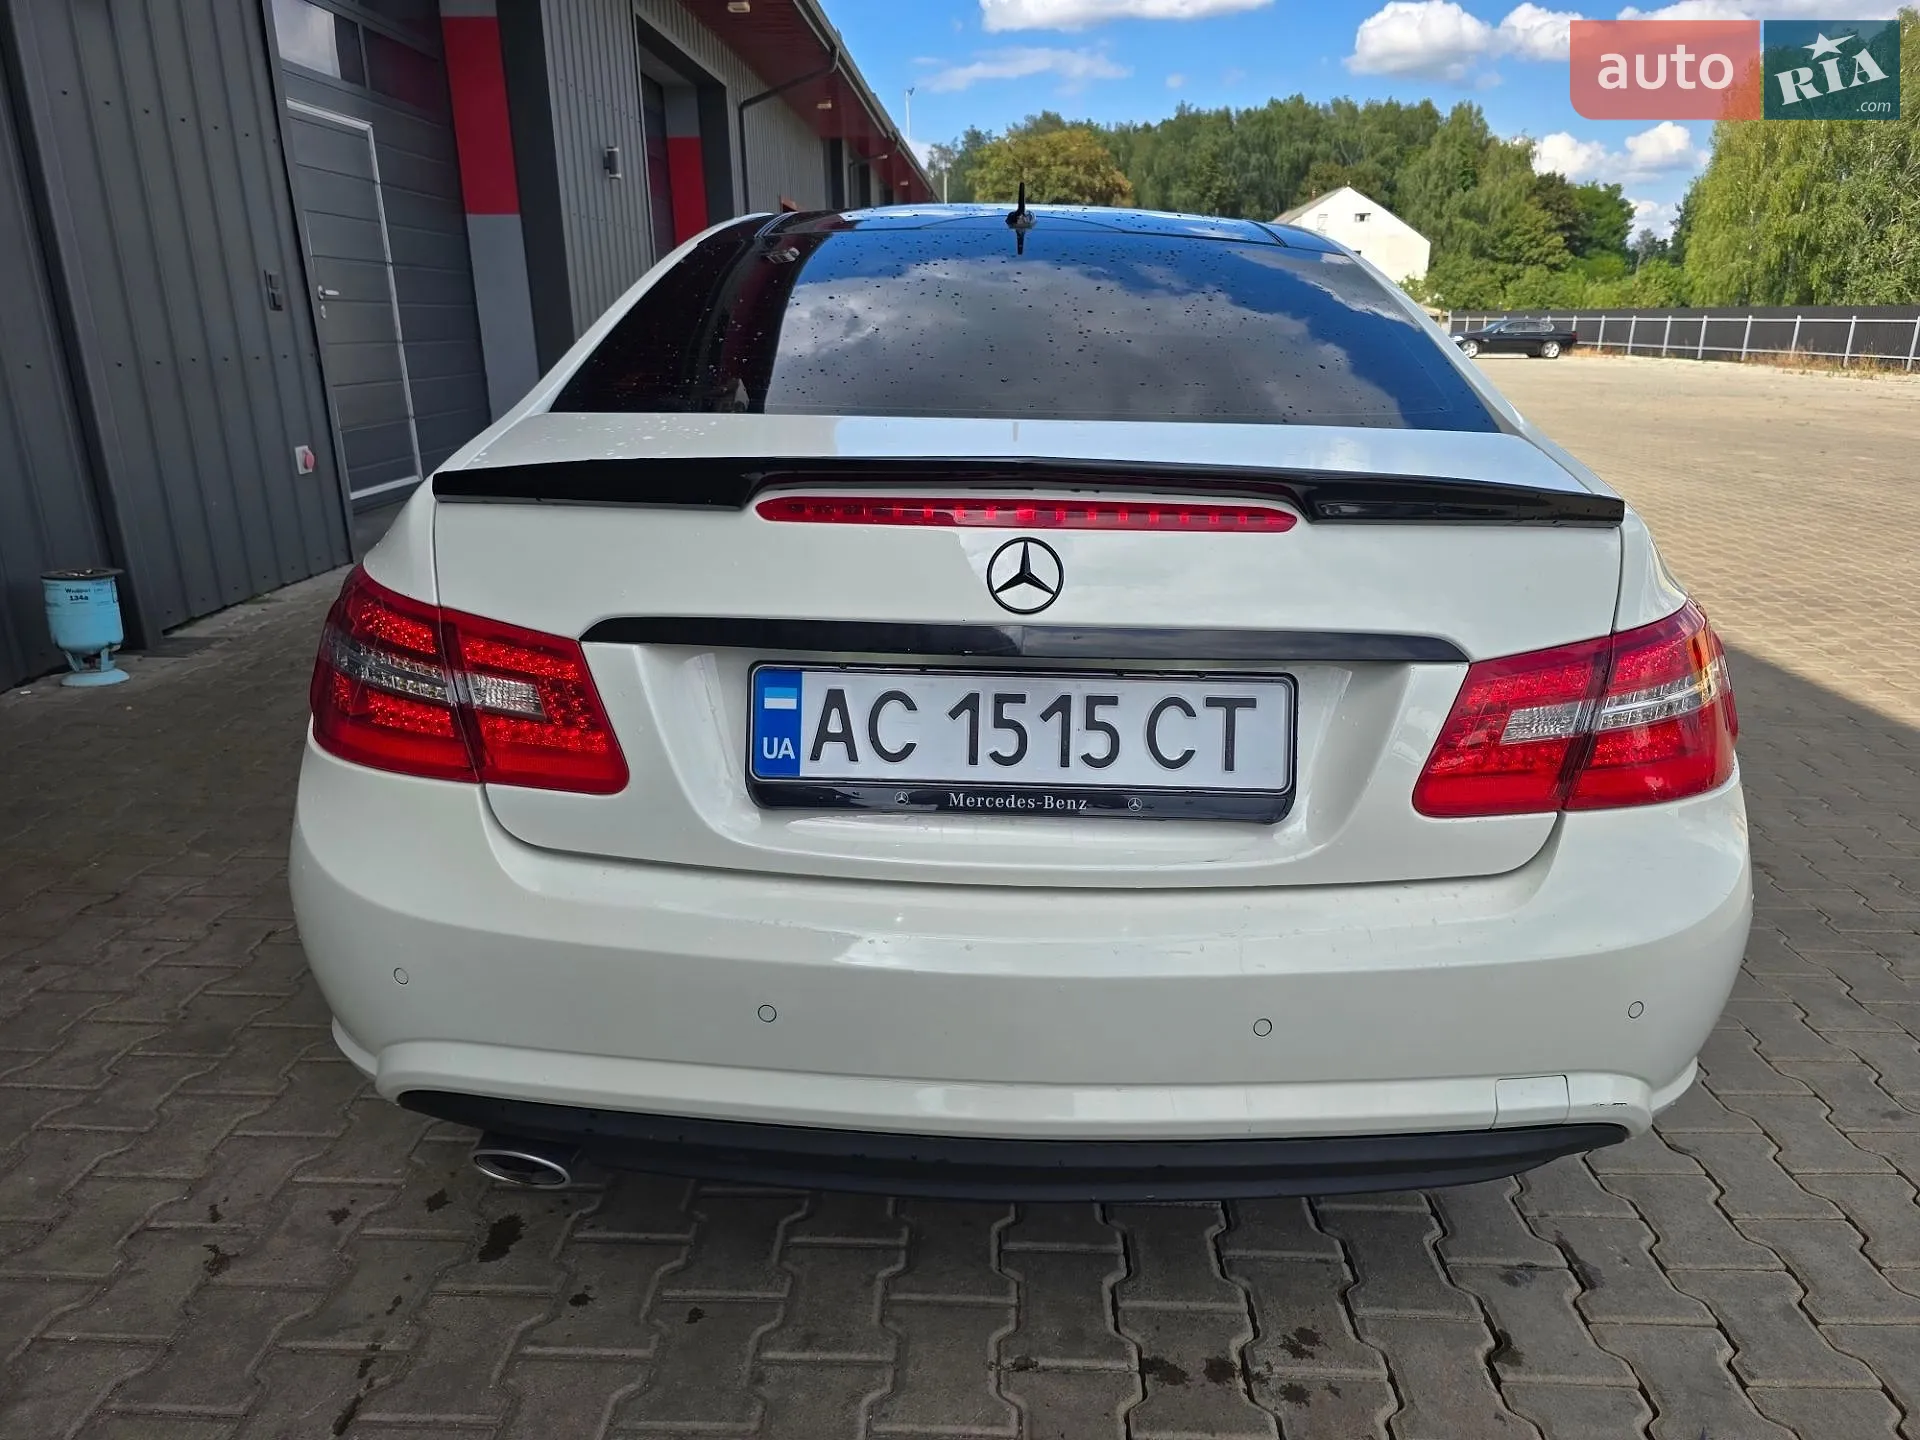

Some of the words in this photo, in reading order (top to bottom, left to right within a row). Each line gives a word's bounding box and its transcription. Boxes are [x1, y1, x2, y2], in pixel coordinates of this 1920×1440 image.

[809, 688, 918, 763] AC
[947, 692, 1120, 769] 1515
[1146, 696, 1257, 771] CT
[763, 736, 796, 759] UA
[949, 792, 1088, 810] Mercedes-Benz
